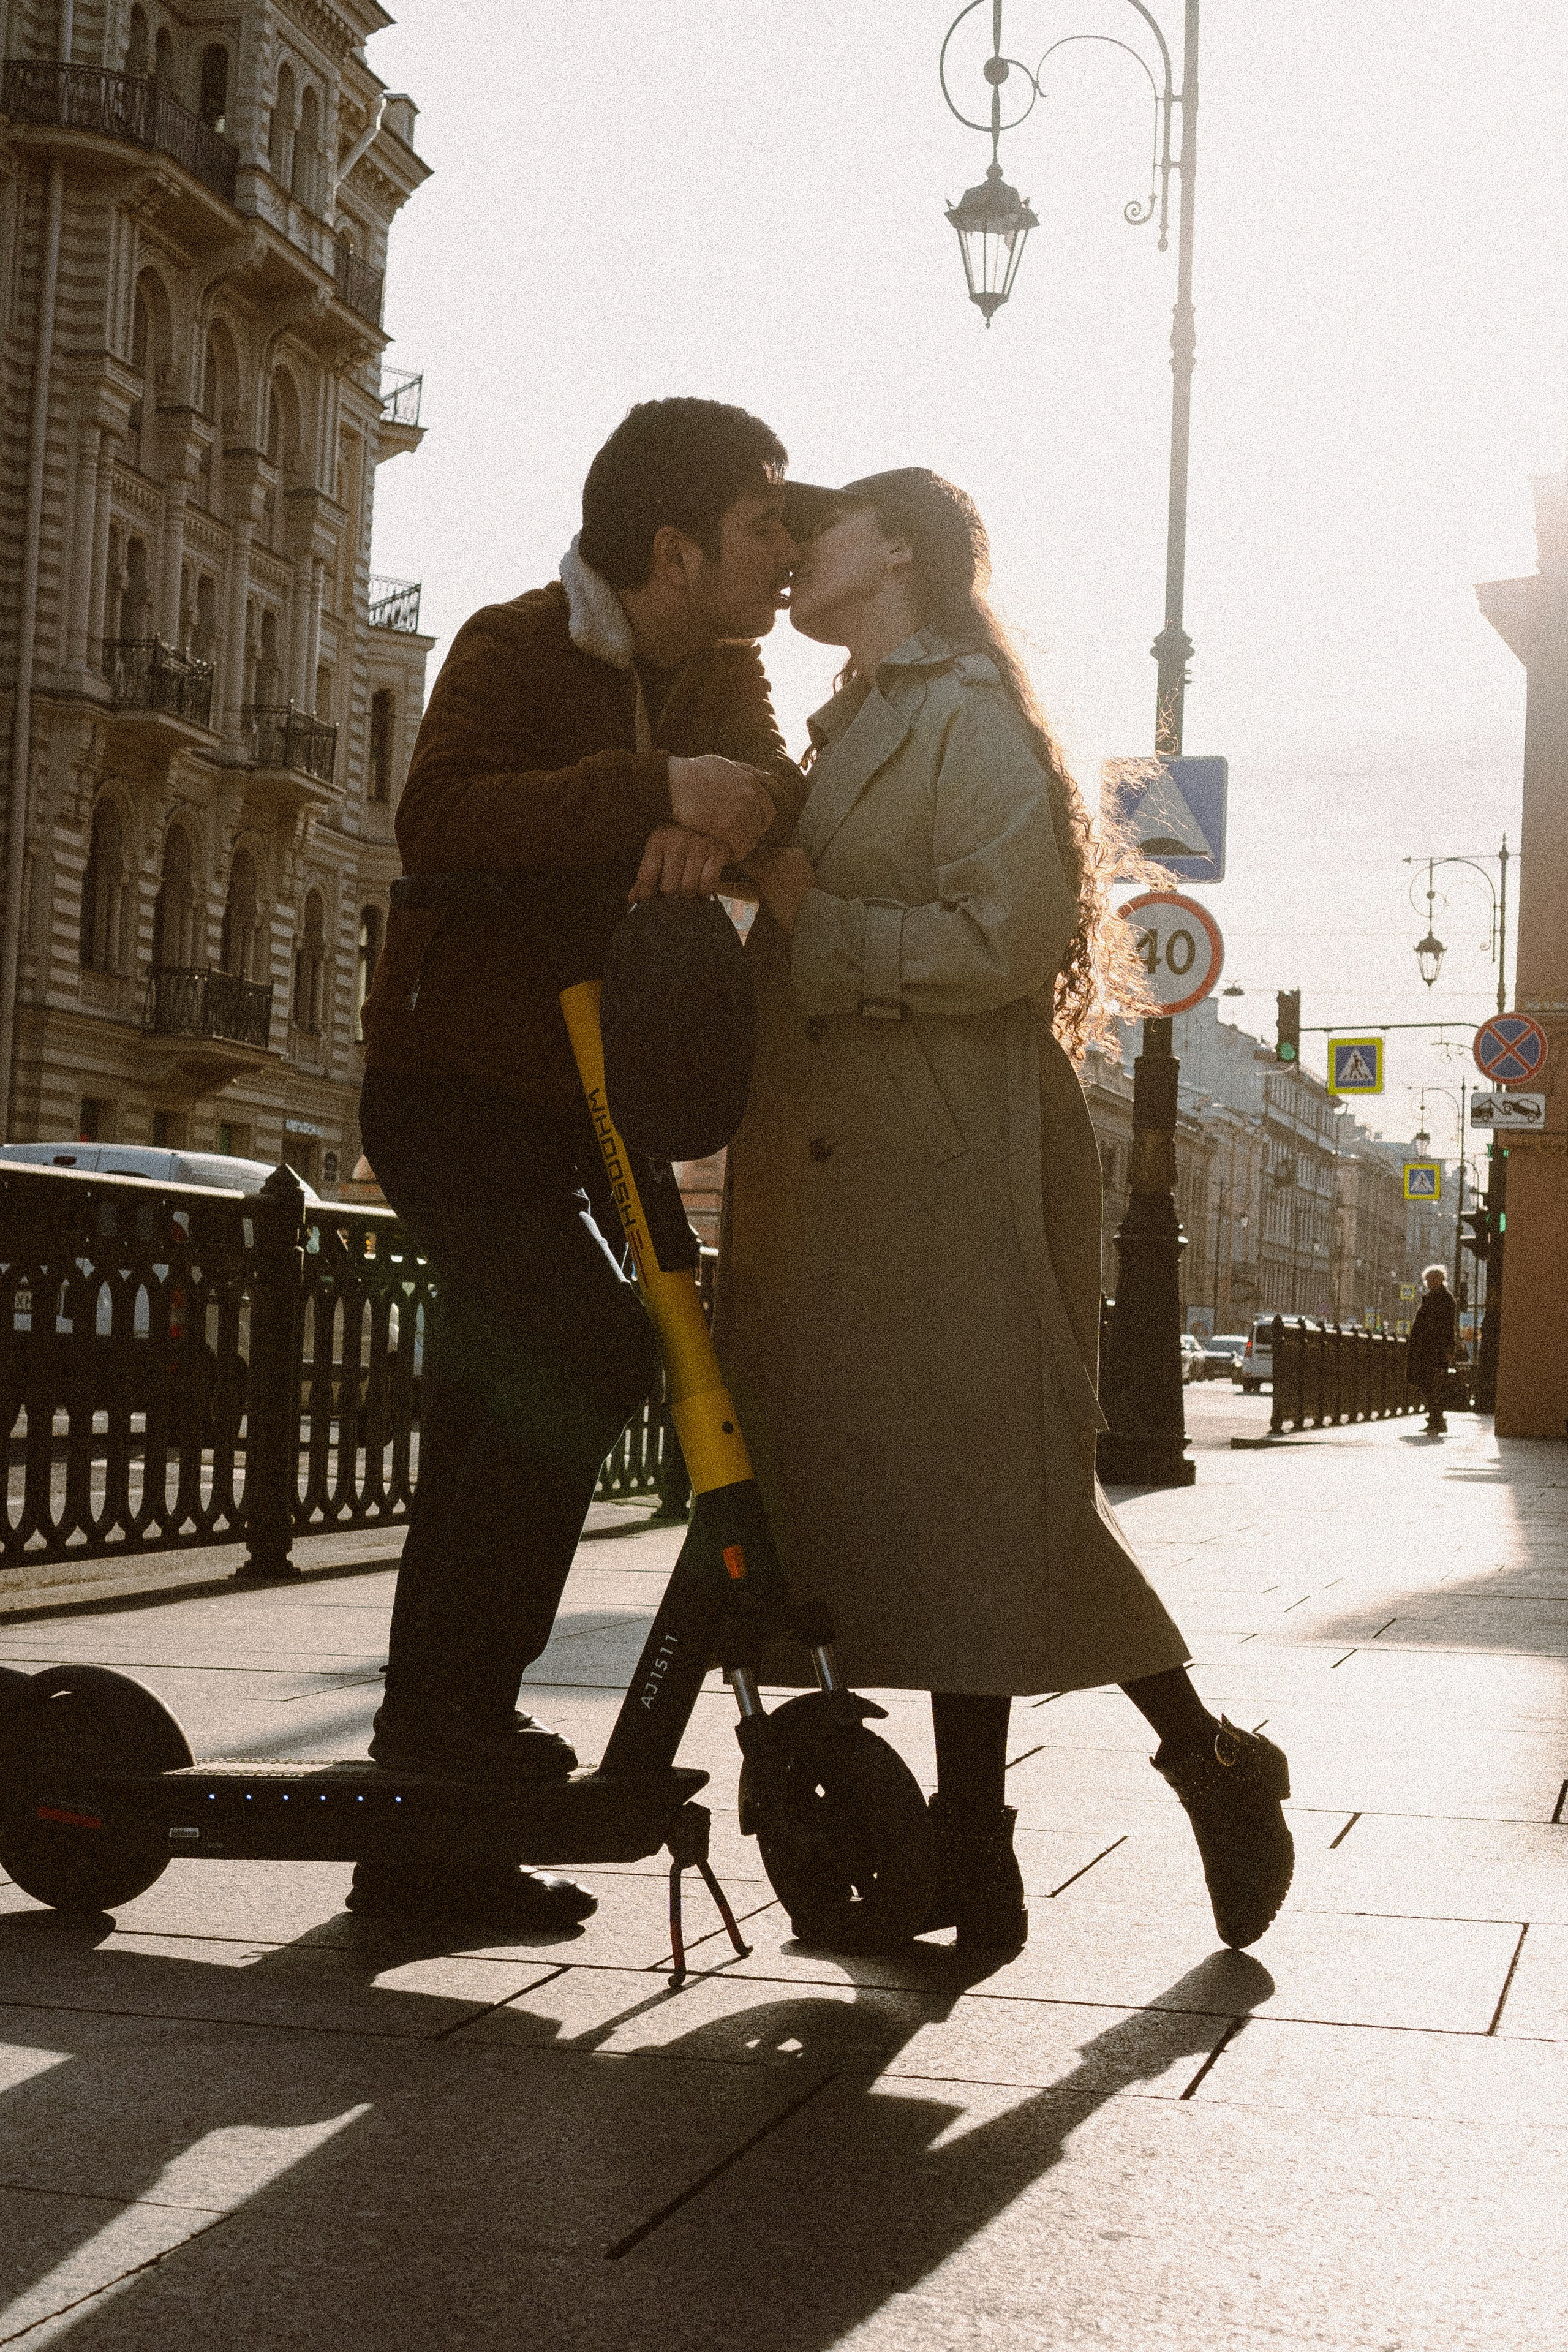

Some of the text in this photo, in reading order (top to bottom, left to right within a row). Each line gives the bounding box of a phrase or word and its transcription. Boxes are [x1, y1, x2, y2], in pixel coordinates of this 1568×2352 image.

[1133, 929, 1196, 975] 40
[589, 1088, 636, 1226] WHOOSH
[641, 1634, 678, 1709] AJ1511
